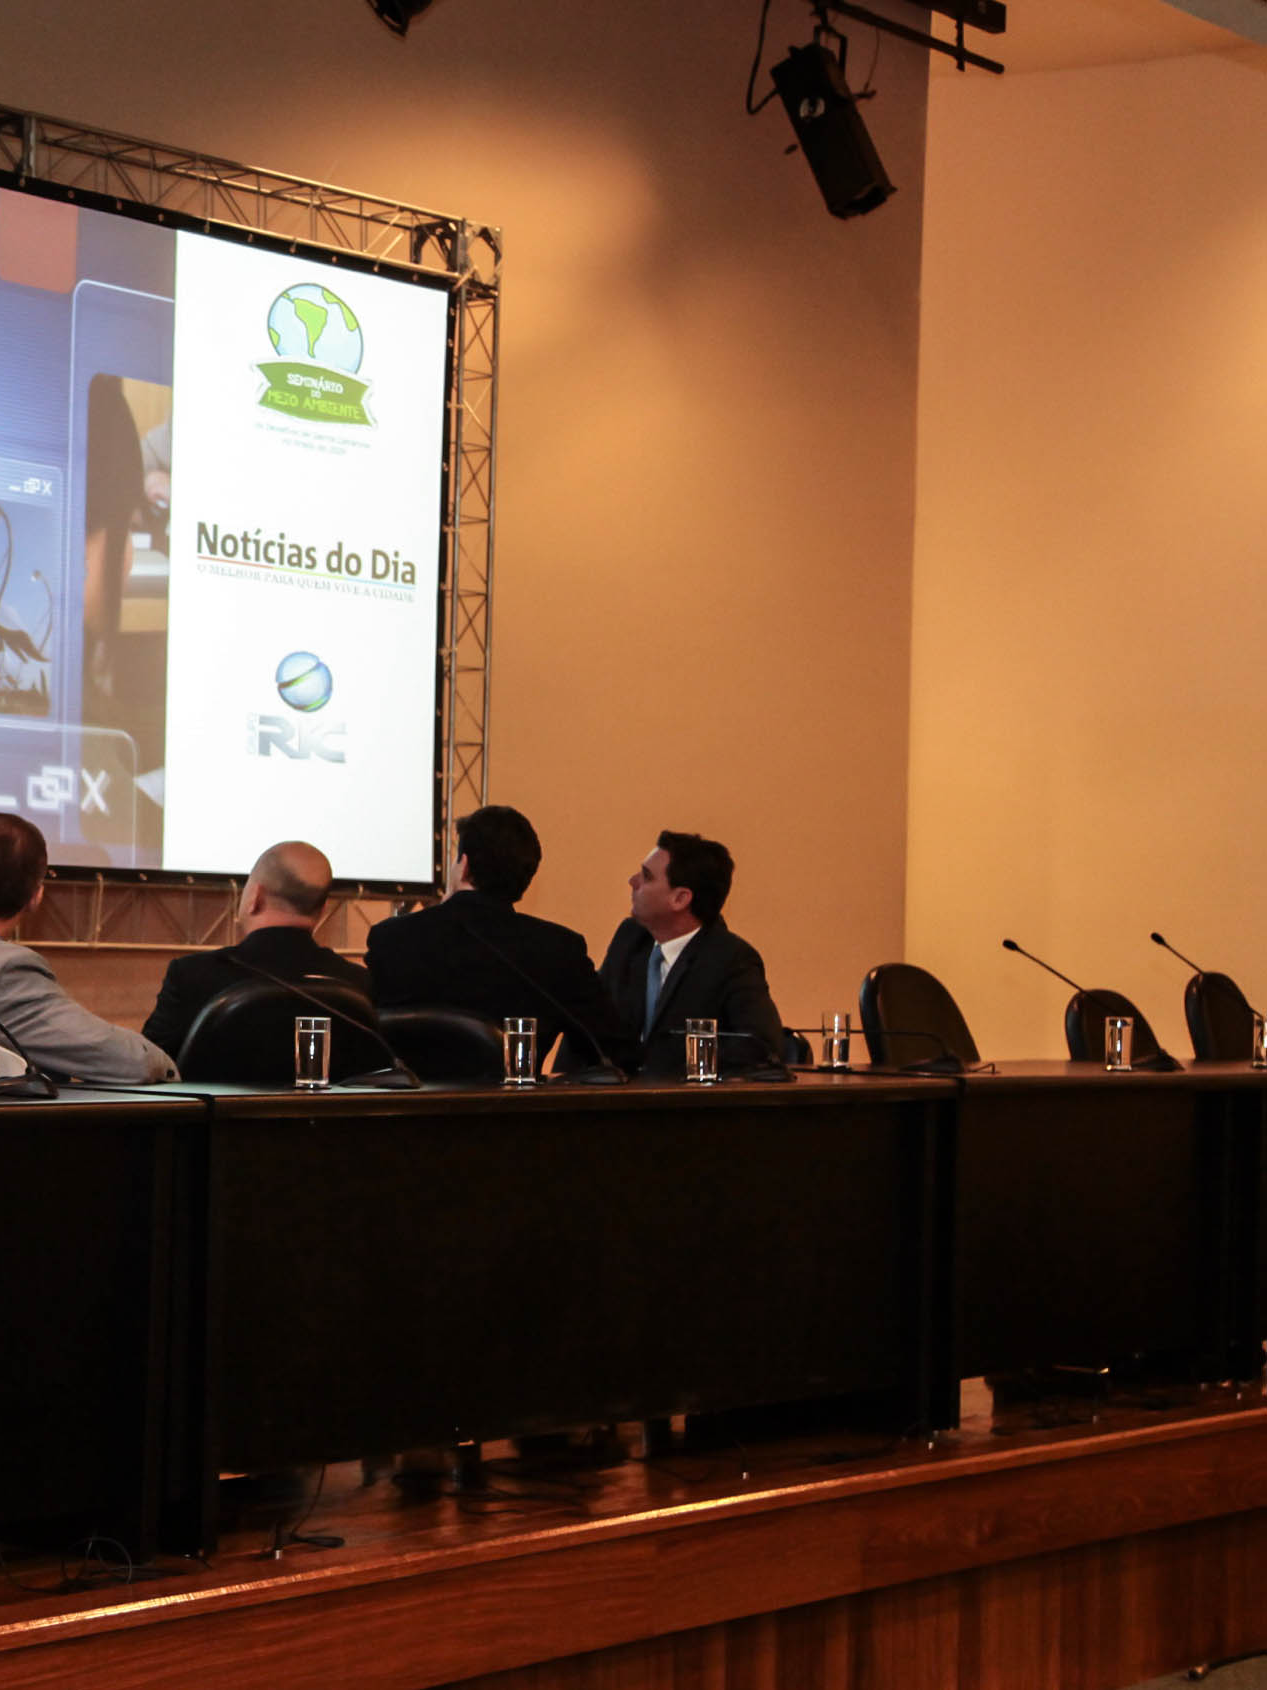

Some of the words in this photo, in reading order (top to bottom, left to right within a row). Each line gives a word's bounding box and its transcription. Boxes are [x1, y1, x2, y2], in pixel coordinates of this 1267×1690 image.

[196, 521, 317, 571] Notícias
[326, 541, 362, 577] do
[371, 549, 416, 585] Dia
